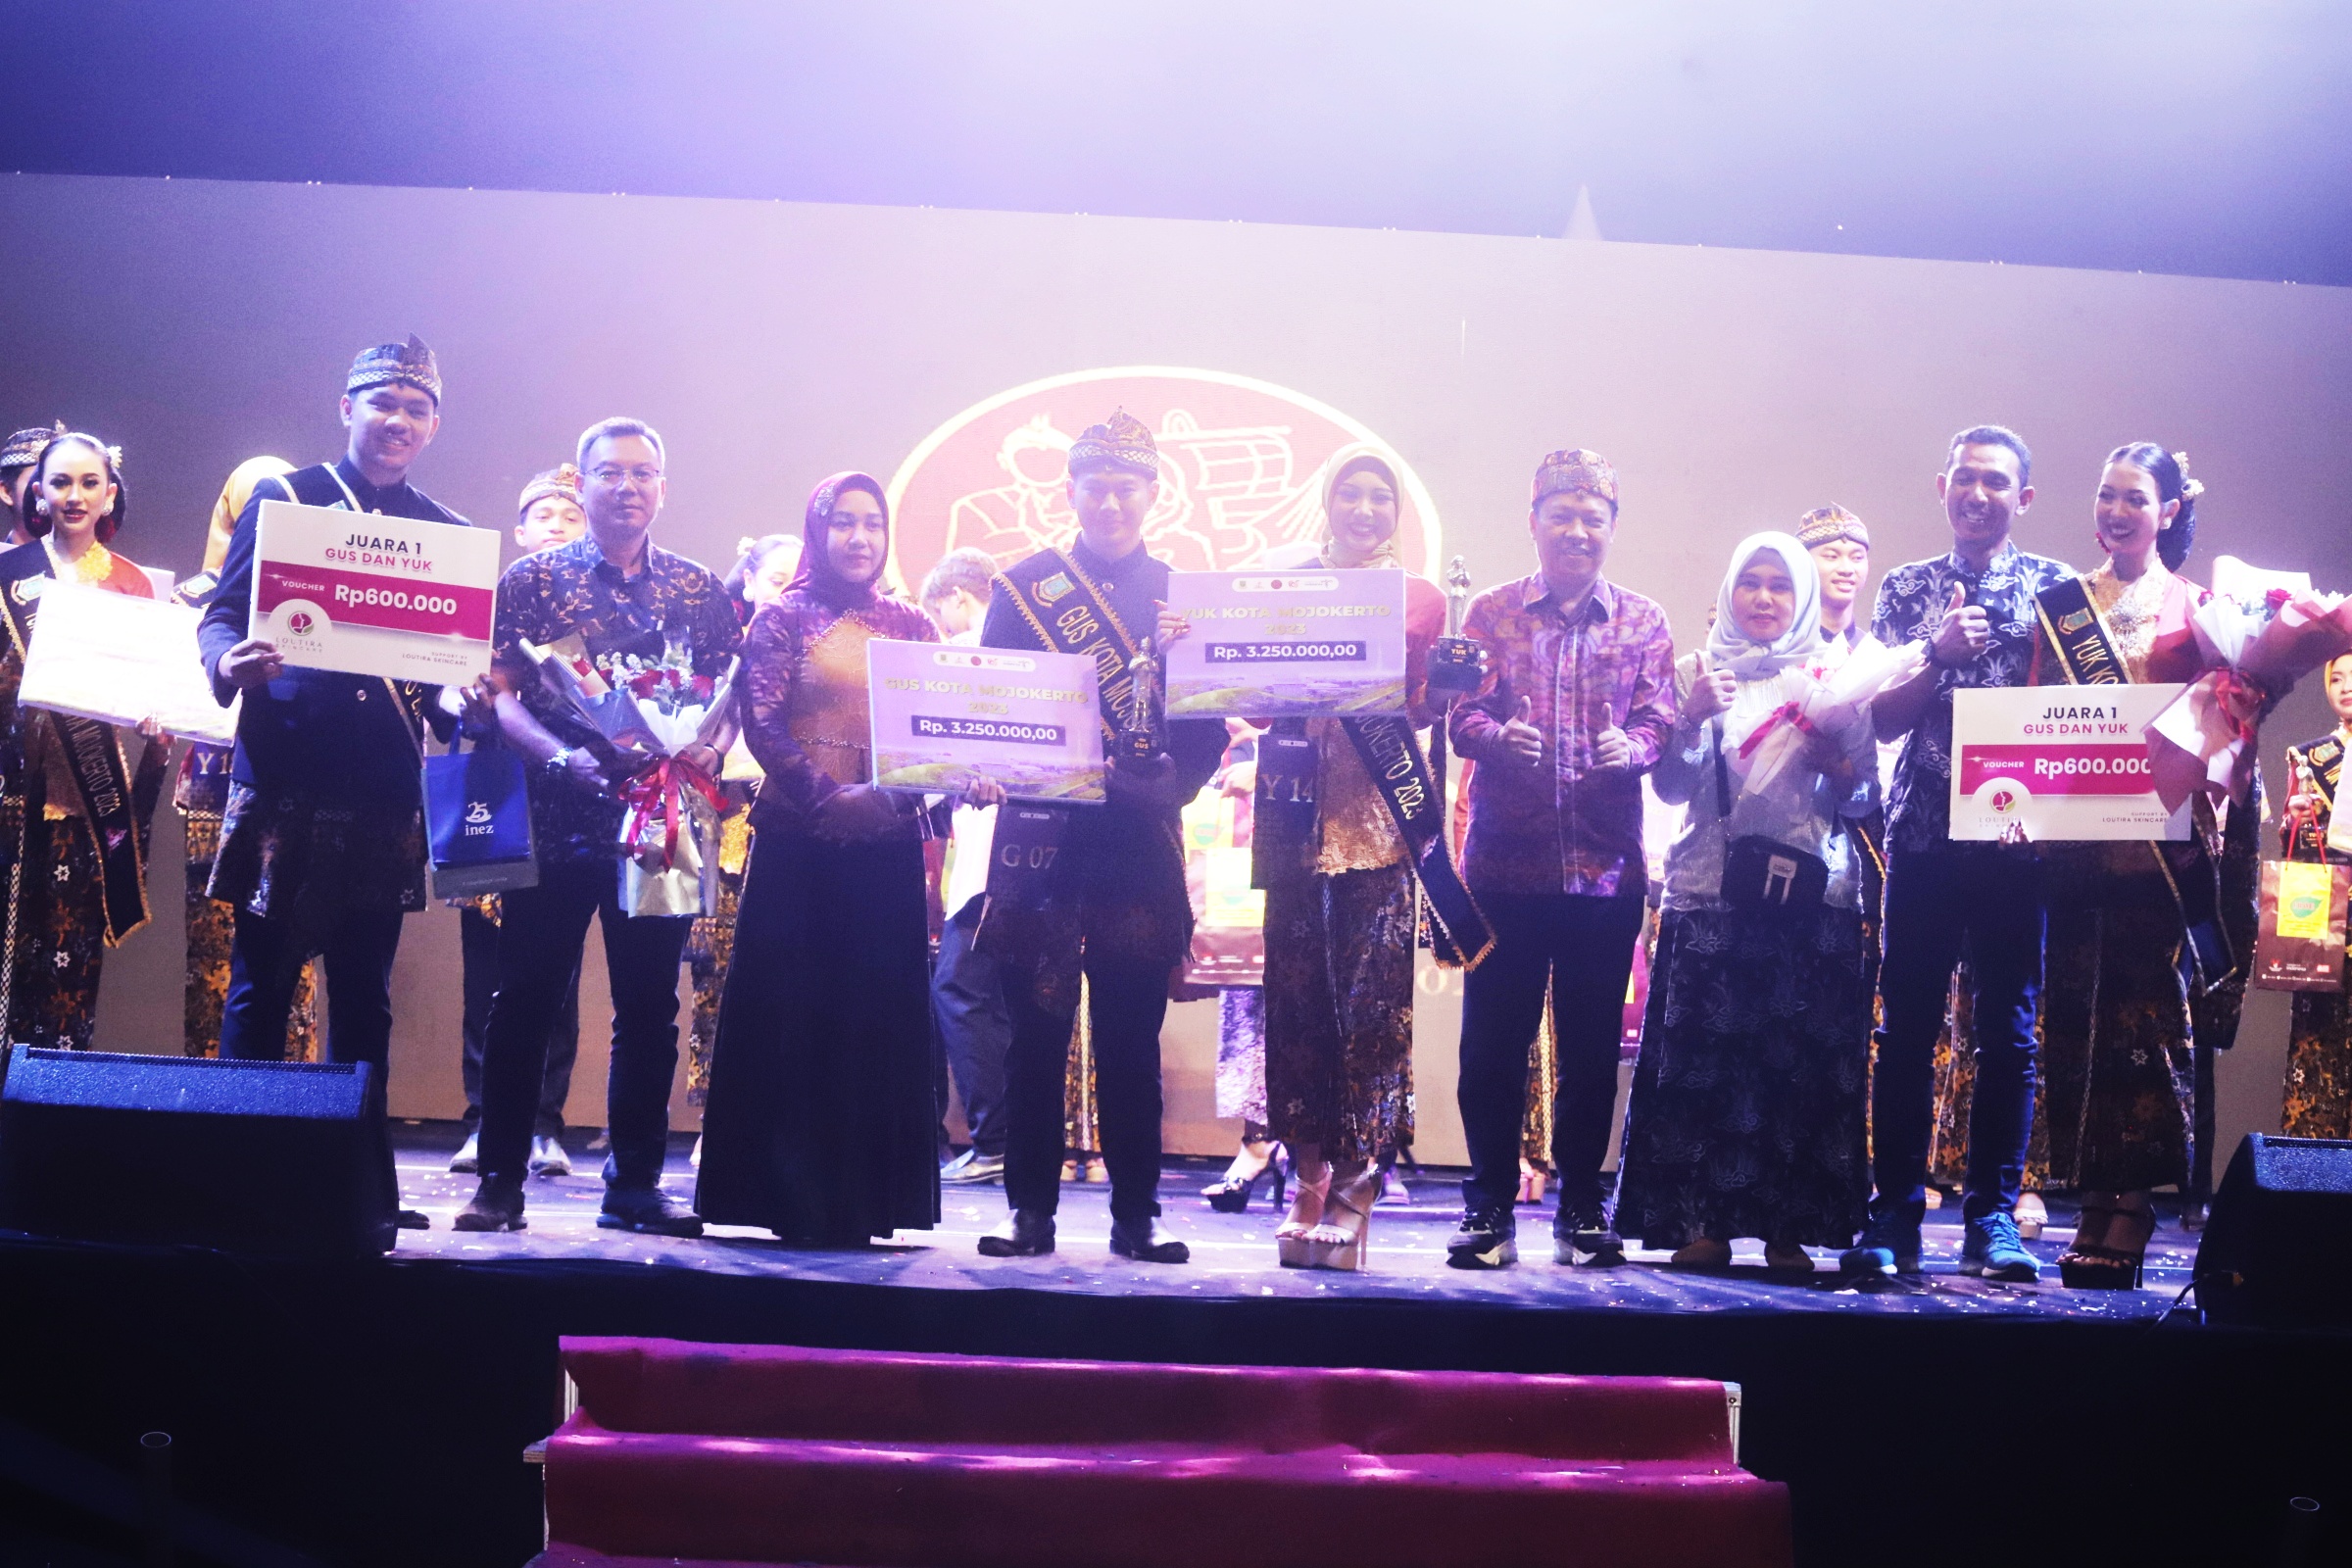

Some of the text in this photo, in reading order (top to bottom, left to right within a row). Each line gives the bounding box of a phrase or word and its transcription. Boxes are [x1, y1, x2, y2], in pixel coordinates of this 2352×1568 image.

[346, 534, 421, 555] JUARA 1
[325, 548, 432, 571] GUS DAN YUK
[281, 580, 457, 615] VOUCHER Rp600.000
[1182, 606, 1392, 620] YUK KOTA MOJOKERTO
[1056, 605, 1100, 644] GUS
[1264, 623, 1306, 636] 2023
[402, 653, 467, 666] LOUTIRA SKINCARE
[1214, 644, 1357, 661] Rp. 3.250.000,00
[2072, 634, 2109, 672] YUK
[884, 677, 1089, 704] GUS KOTA MOJOKERTO
[2042, 707, 2117, 719] JUARA 1
[919, 719, 1057, 742] Rp. 3.250.000,00
[2024, 723, 2129, 735] GUS DAN YUK
[197, 753, 215, 774] Y
[1983, 760, 2025, 769] VOUCHER
[1260, 773, 1315, 803] Y 14
[465, 824, 494, 836] inez
[1001, 844, 1059, 869] G 07
